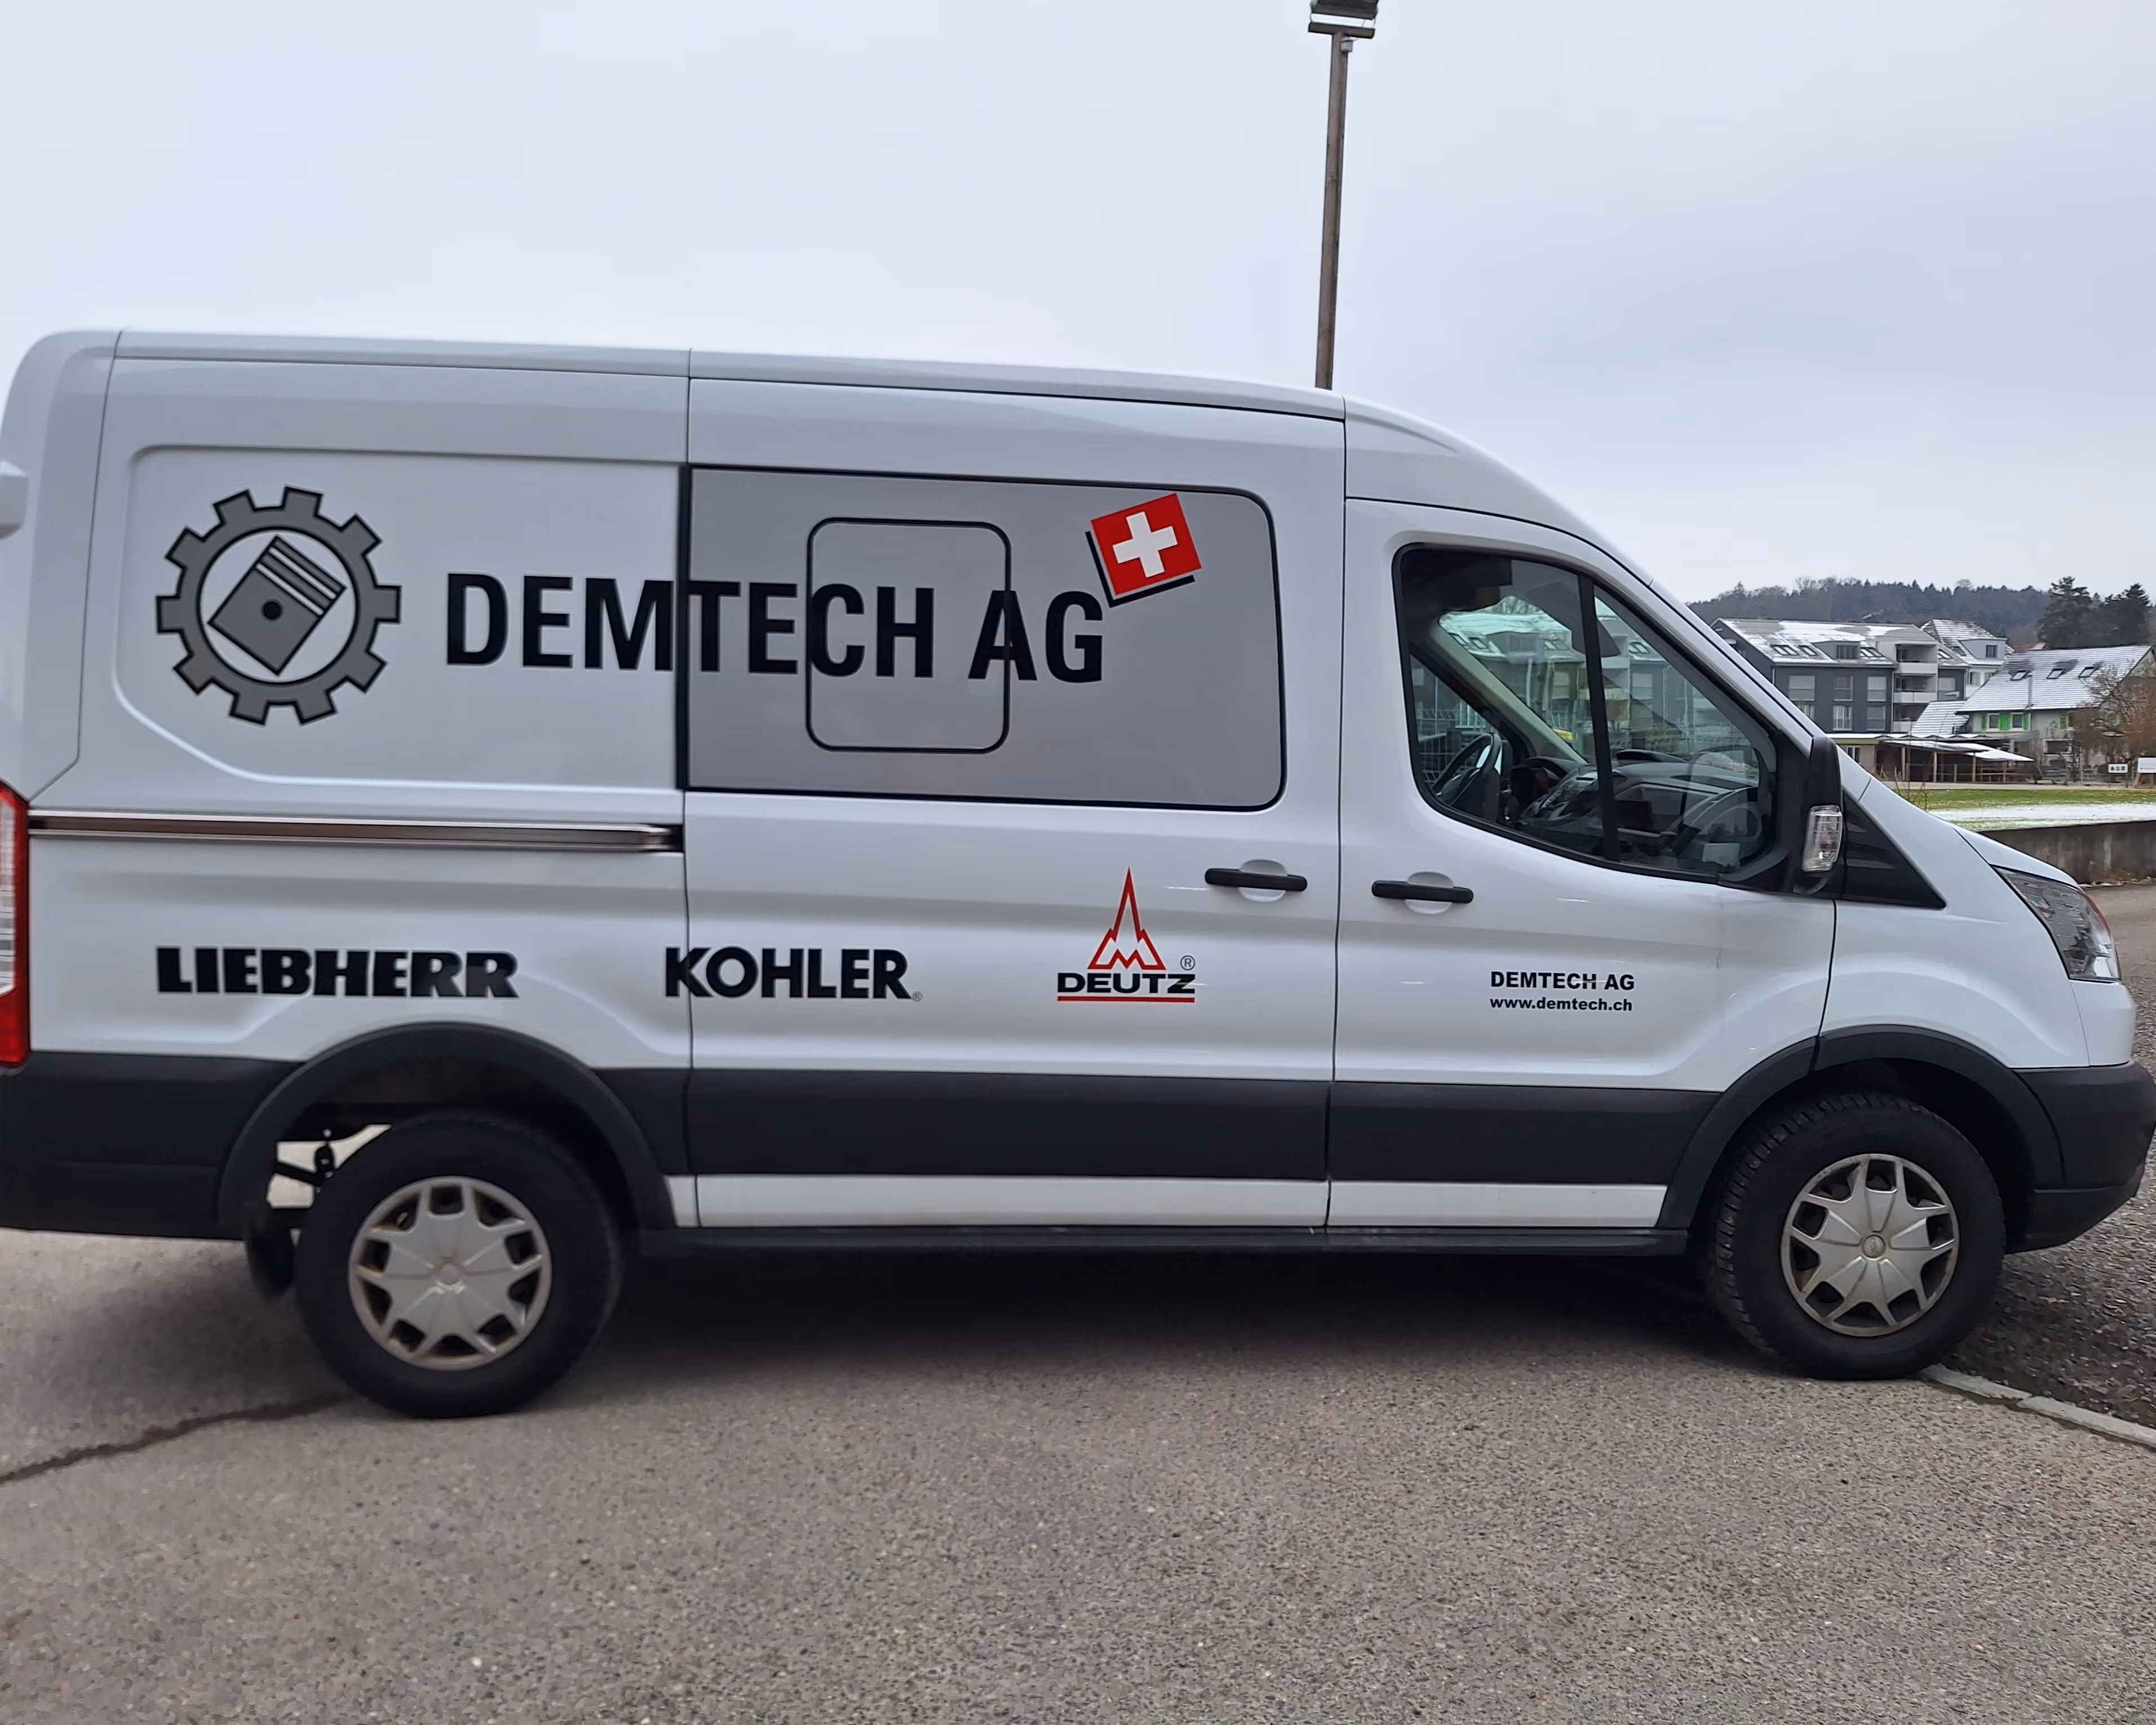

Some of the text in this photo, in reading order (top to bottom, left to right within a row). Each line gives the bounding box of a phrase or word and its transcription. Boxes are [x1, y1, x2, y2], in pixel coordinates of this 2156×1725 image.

[446, 572, 1103, 683] DEMTECH AG
[156, 947, 519, 998] LIEBHERR
[665, 946, 912, 999] KOHLER
[1057, 972, 1196, 994] DEUTZ
[1490, 971, 1635, 990] DEMTECH AG
[1490, 997, 1632, 1011] www.demtech.ch
